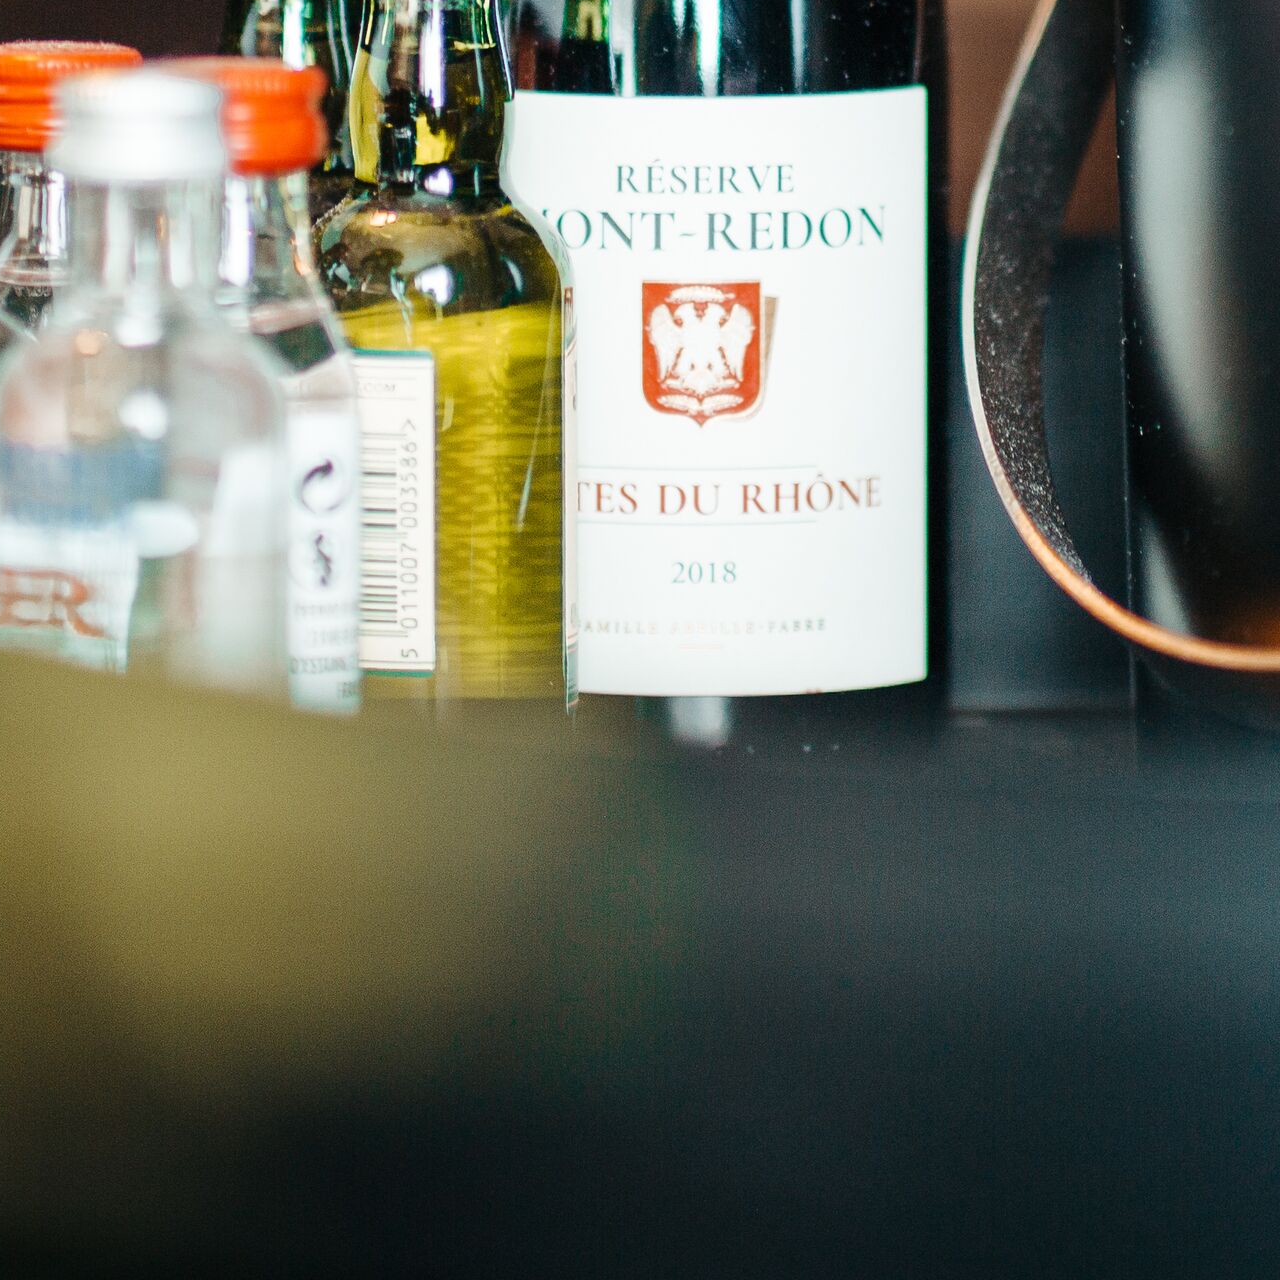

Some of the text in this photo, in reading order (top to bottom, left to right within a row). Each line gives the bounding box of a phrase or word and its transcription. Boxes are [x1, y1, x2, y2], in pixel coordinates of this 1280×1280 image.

[616, 159, 795, 195] RÉSERVE
[541, 205, 886, 252] ONT-REDON
[577, 473, 883, 517] TES DU RHÔNE
[670, 560, 738, 585] 2018
[578, 619, 660, 636] AMILLE
